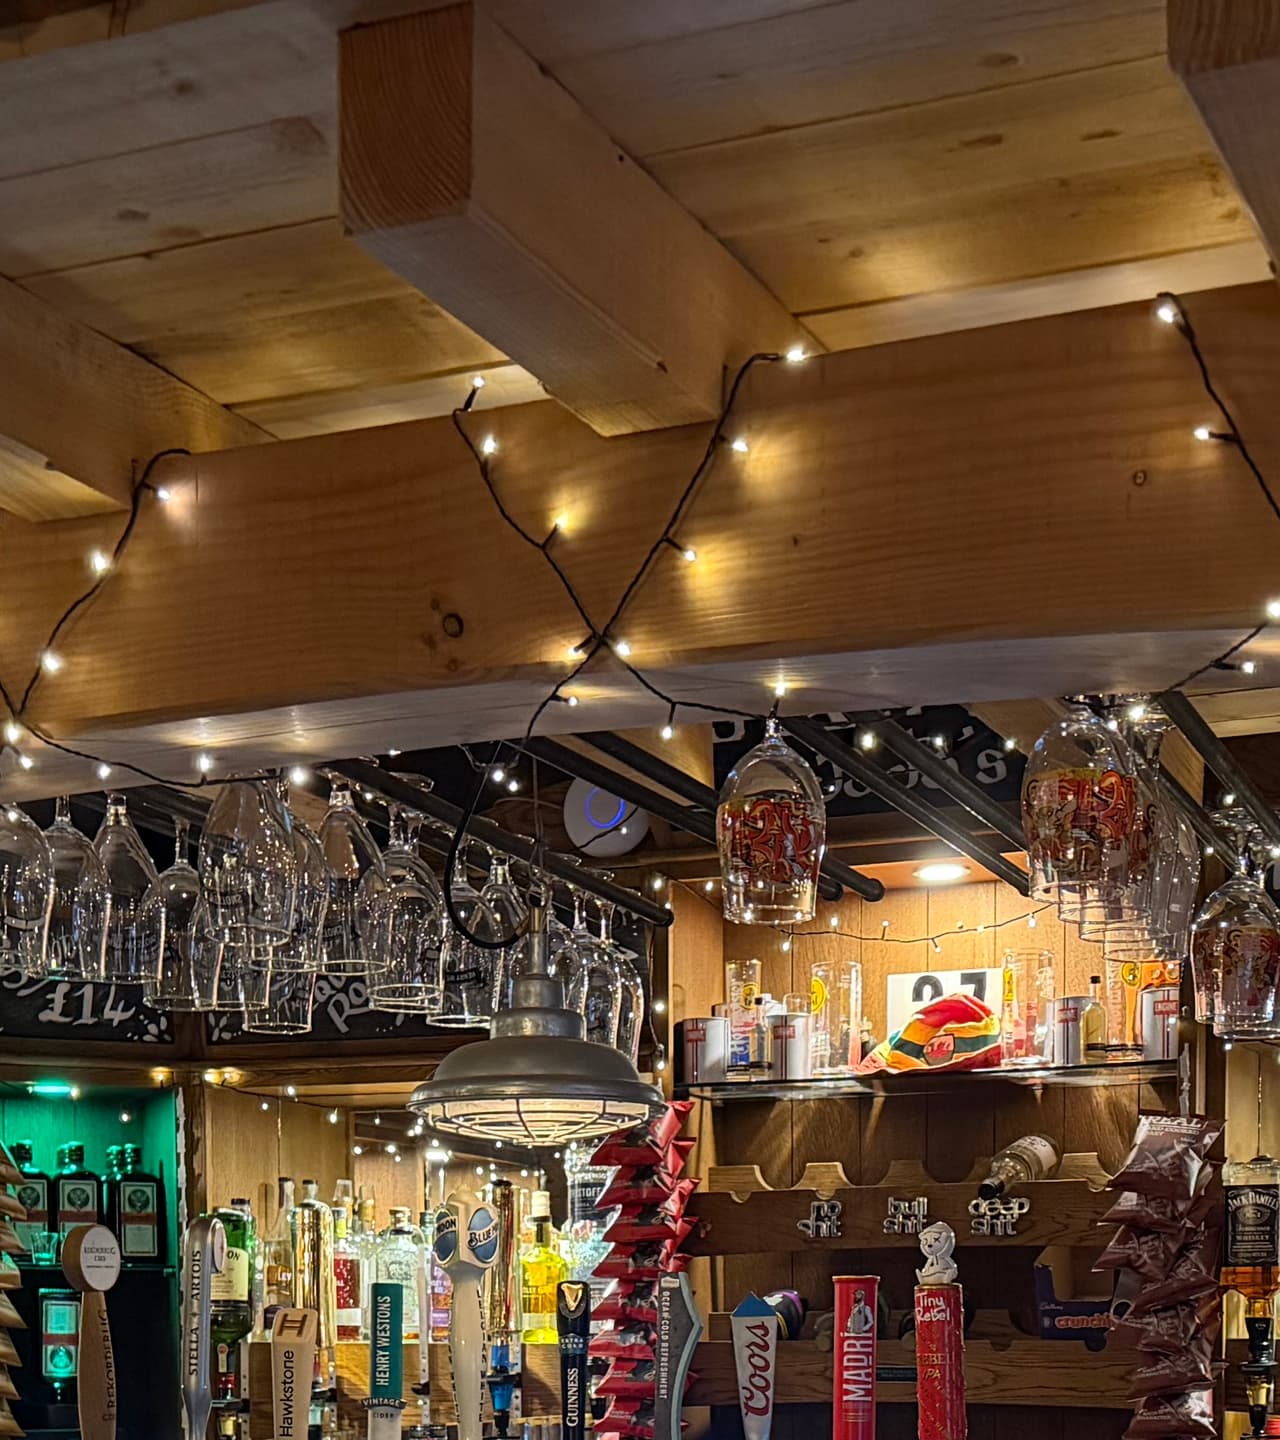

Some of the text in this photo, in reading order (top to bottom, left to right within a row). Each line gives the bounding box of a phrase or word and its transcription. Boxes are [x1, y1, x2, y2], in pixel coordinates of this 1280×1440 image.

[37, 982, 136, 1028] £14
[810, 1200, 842, 1218] no
[887, 1196, 928, 1216] bull
[968, 1197, 1030, 1217] deep
[883, 1214, 927, 1234] shit
[970, 1215, 1018, 1236] shit
[916, 1290, 946, 1311] Tiny
[188, 1250, 202, 1377] STELLA ARTOIS
[915, 1307, 951, 1323] Rebel
[375, 1295, 392, 1387] HENRY WESTONS
[661, 1320, 670, 1341] COLD
[659, 1342, 669, 1399] REFRESHMENT
[744, 1320, 771, 1418] Coors
[279, 1349, 295, 1438] Hawkstone
[362, 1398, 402, 1408] VINTAGE
[565, 1366, 579, 1428] GUINNESS
